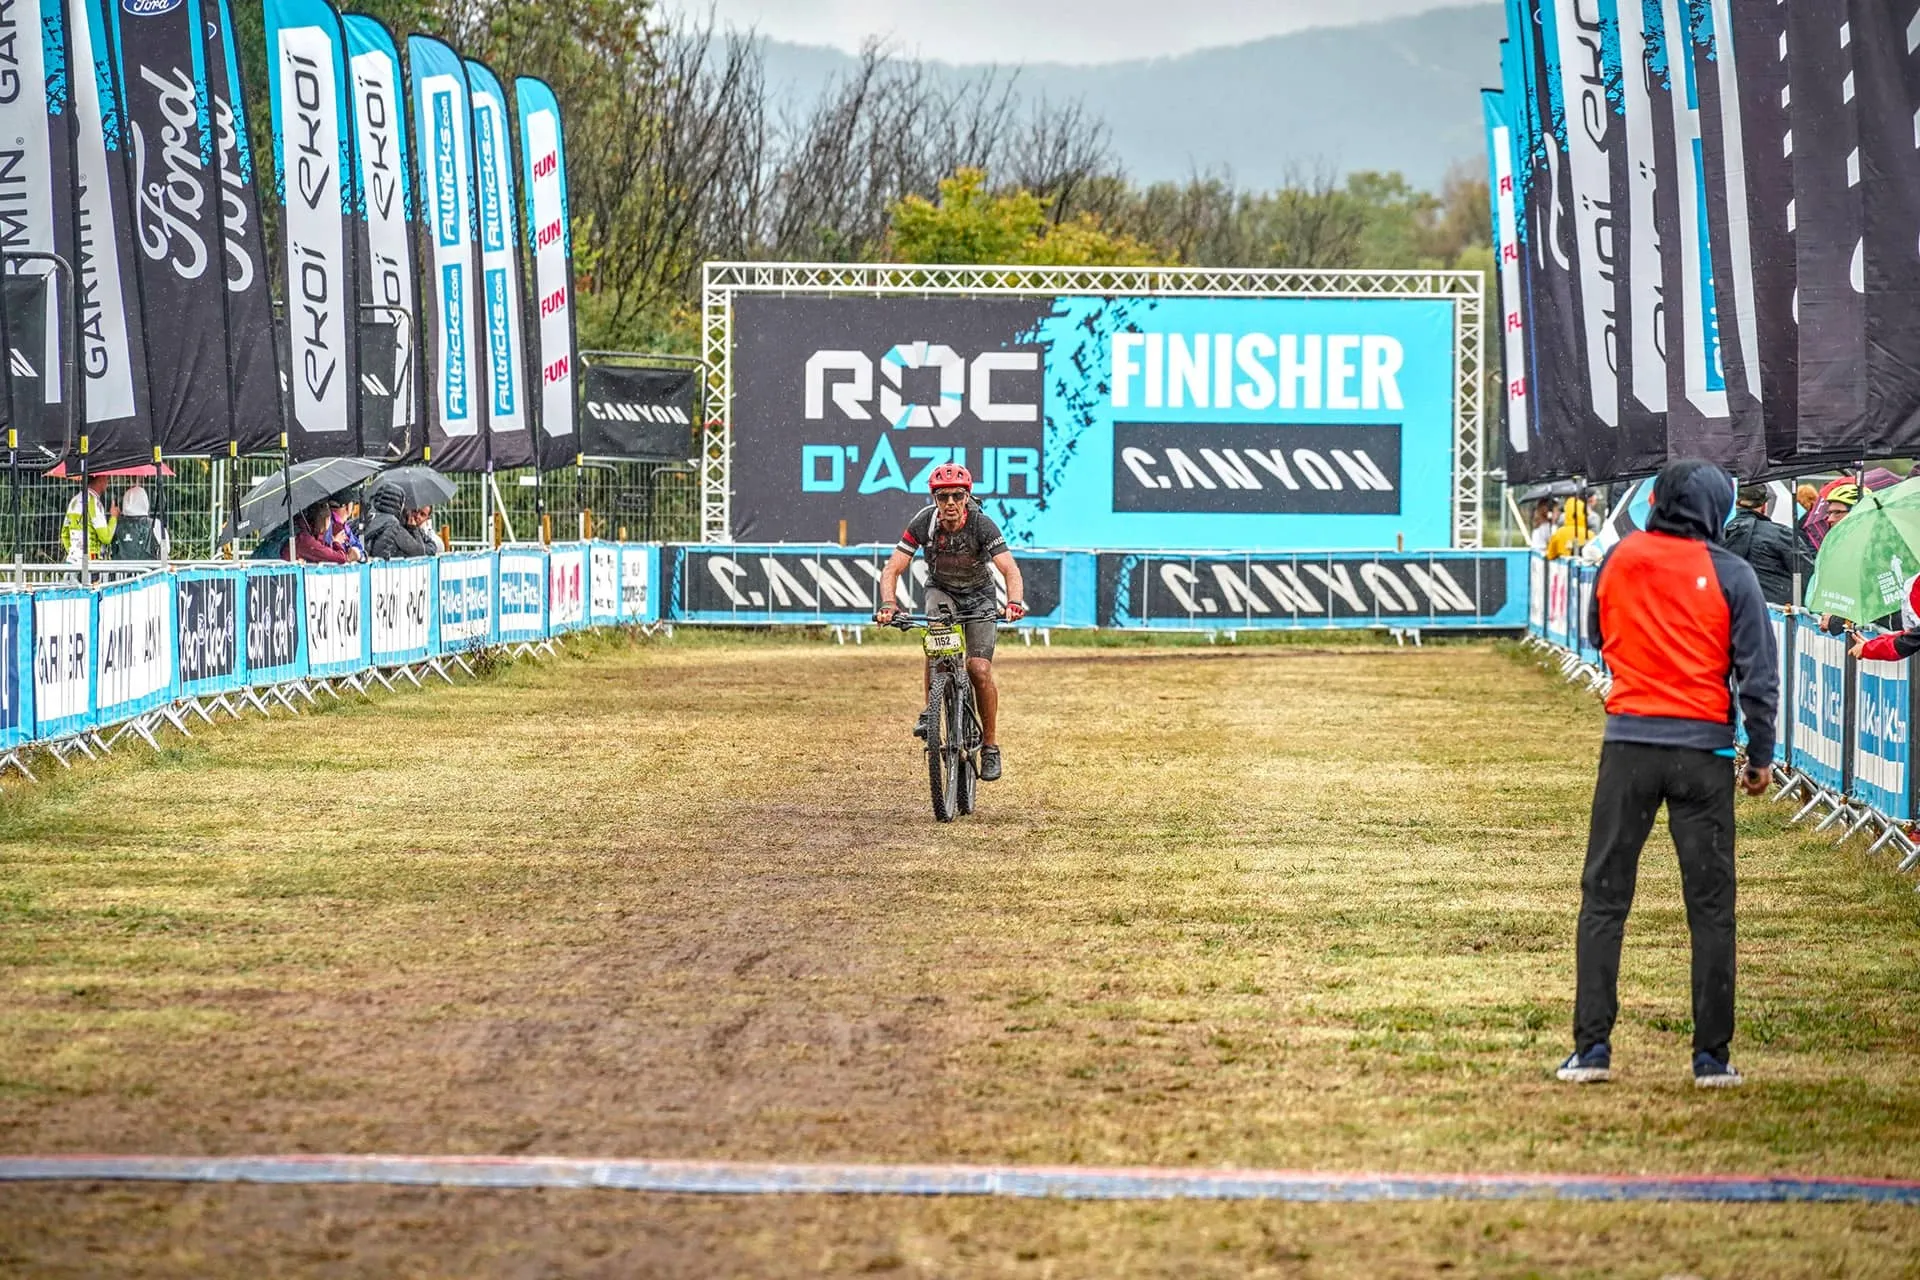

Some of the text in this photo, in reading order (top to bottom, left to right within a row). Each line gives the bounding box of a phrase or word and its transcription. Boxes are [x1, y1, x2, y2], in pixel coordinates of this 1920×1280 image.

[131, 65, 207, 279] Ford
[533, 150, 557, 183] FUN
[1500, 175, 1512, 195] FU
[538, 218, 561, 250] FUN
[1503, 242, 1518, 265] FU
[541, 286, 565, 318] FUN
[1507, 311, 1523, 333] FU
[543, 355, 568, 387] FUN
[804, 339, 1038, 429] ROC
[1110, 330, 1404, 410] FINISHER
[1509, 378, 1526, 400] FU
[587, 401, 689, 424] CANYON
[801, 432, 1039, 495] D'AZUR
[1121, 446, 1394, 491] CANYON
[707, 555, 1030, 611] CANY
[1159, 561, 1476, 612] CANYON
[934, 636, 951, 647] 1152
